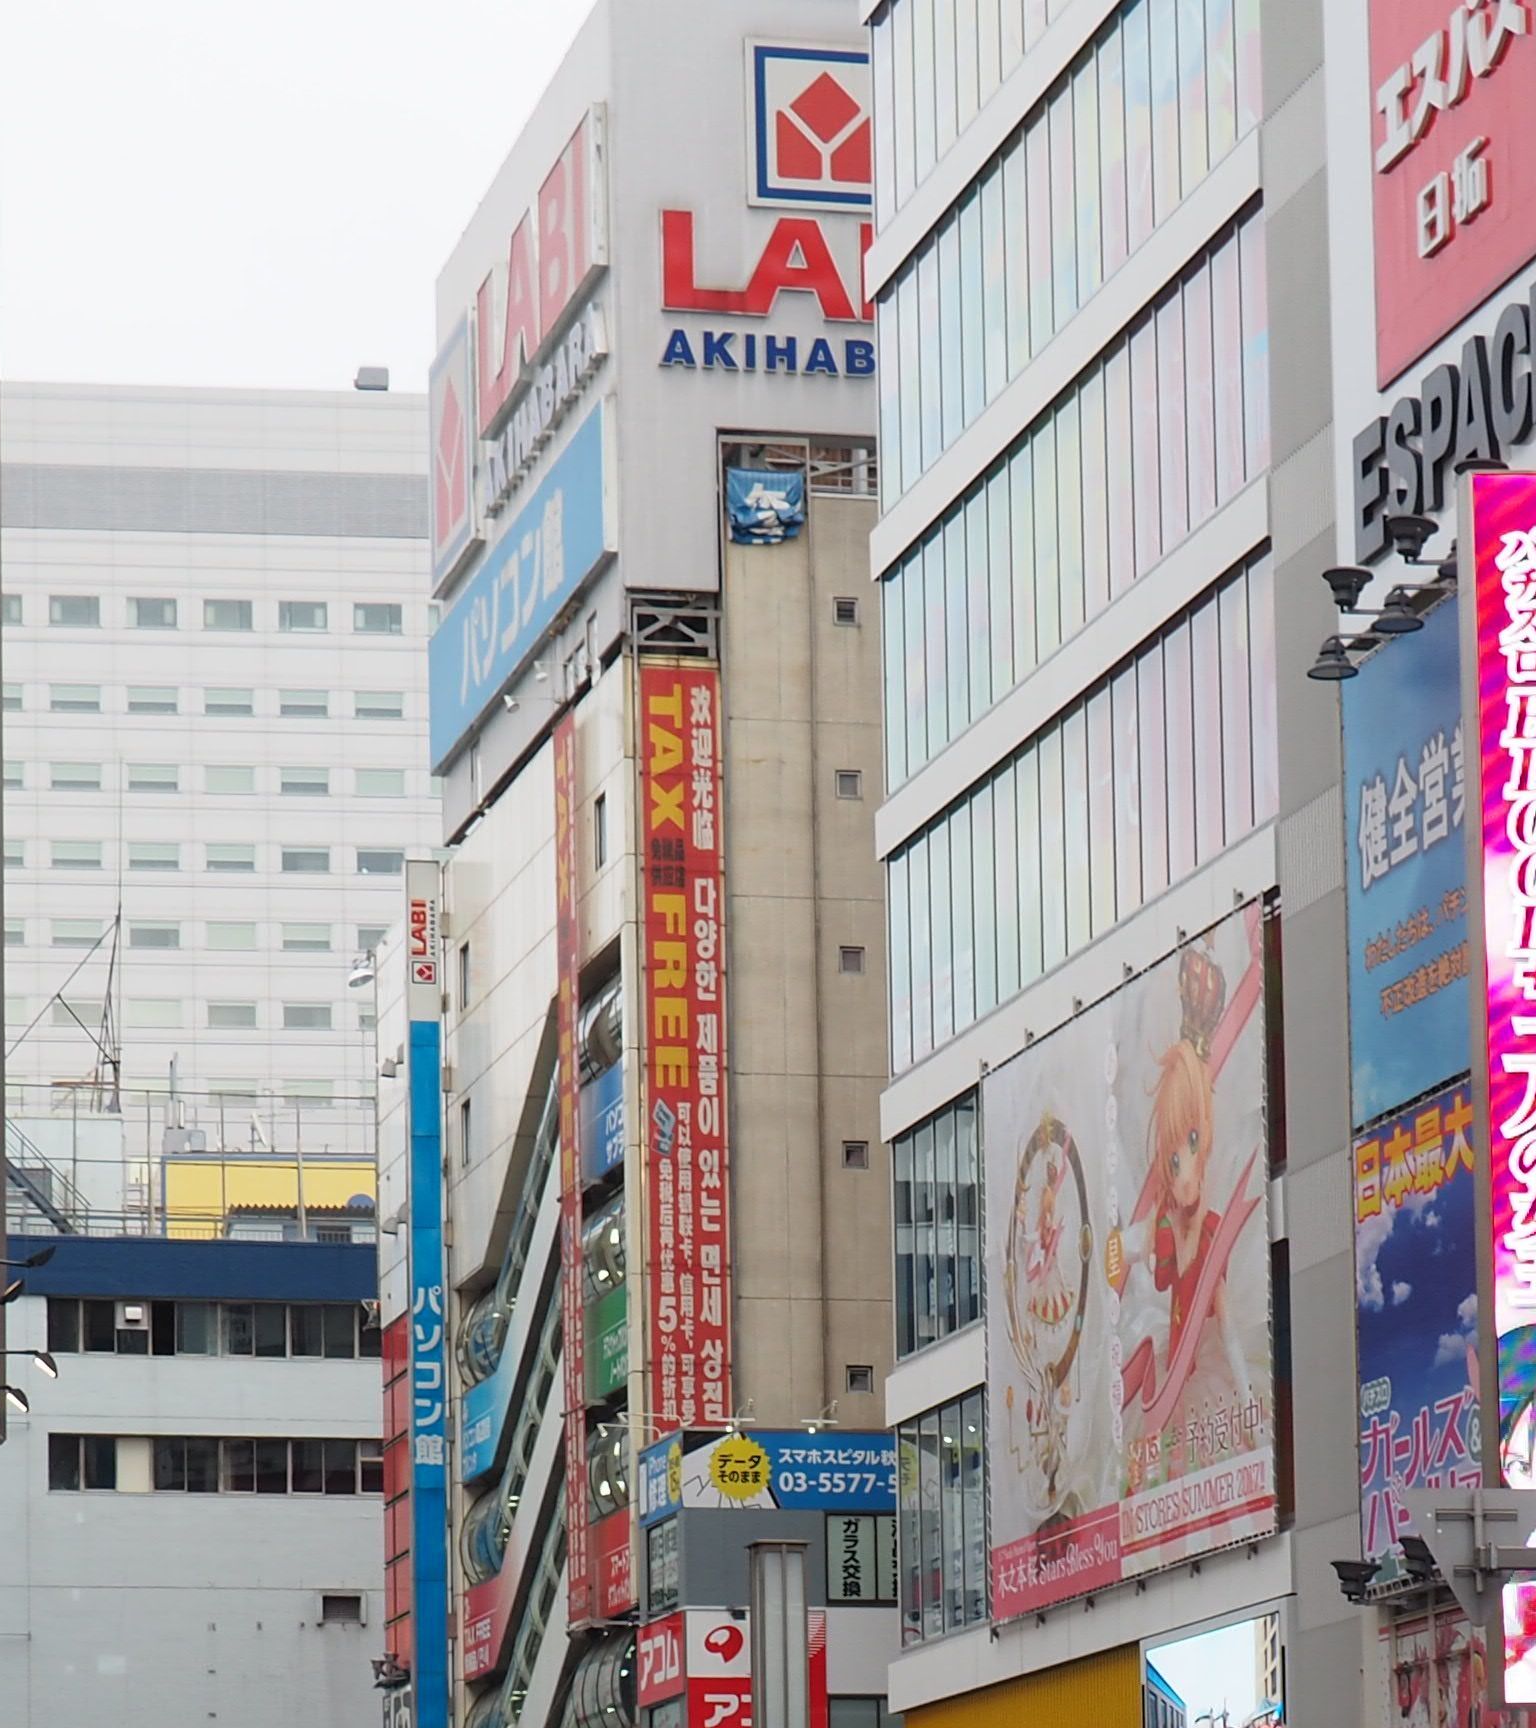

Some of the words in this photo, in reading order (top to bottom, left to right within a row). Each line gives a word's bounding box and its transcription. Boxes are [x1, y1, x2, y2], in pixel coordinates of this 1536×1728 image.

[660, 209, 874, 322] LA
[648, 682, 685, 832] TAX
[409, 899, 428, 957] LABI
[652, 893, 690, 1090] FREE
[413, 1286, 444, 1467] パソコン館
[717, 1454, 761, 1468] データ
[717, 1470, 761, 1484] そのまま
[842, 1518, 861, 1598] ガラス交換
[639, 1628, 680, 1693] アコム
